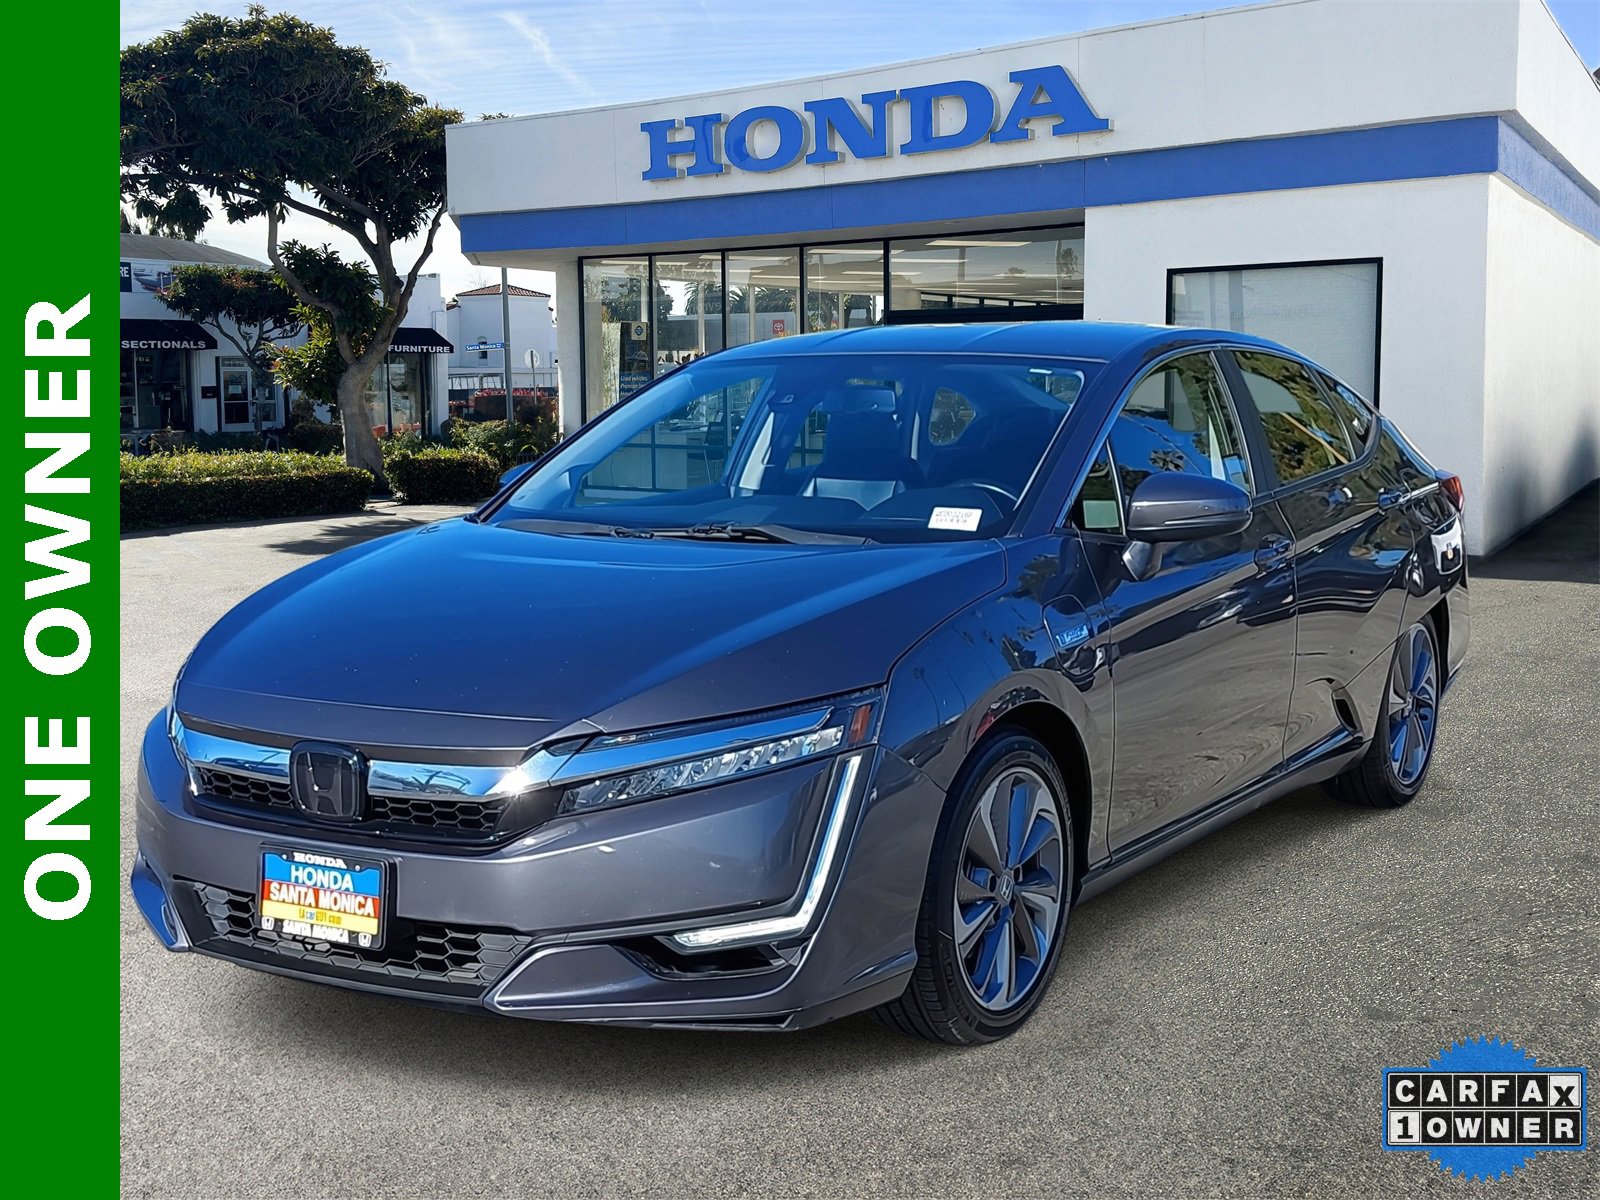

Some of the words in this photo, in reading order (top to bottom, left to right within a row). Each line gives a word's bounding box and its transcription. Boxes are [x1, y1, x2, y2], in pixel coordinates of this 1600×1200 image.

[640, 64, 1112, 182] HONDA
[121, 340, 206, 349] SECTIONALS
[387, 344, 450, 353] FURNITURE
[293, 852, 347, 869] HONDA
[290, 864, 354, 892] HONDA
[269, 882, 317, 907] SANTA
[318, 890, 375, 917] MONICA
[282, 919, 311, 937] SANTA
[312, 924, 350, 943] MONICA
